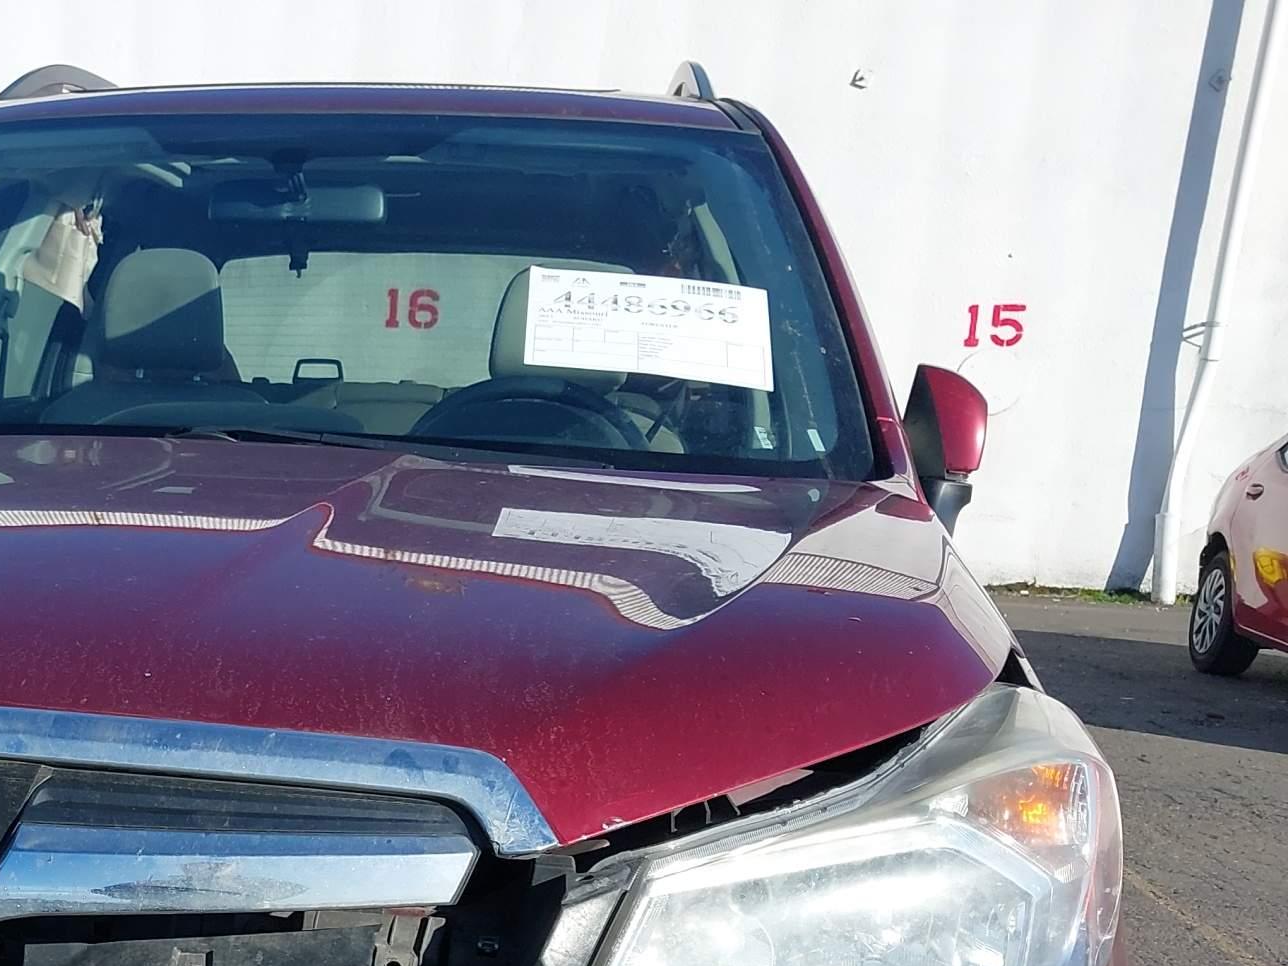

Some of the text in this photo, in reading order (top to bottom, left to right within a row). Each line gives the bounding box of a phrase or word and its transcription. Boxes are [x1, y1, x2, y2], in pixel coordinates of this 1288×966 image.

[385, 288, 440, 329] 16
[553, 290, 739, 325] 44486966
[963, 304, 1027, 347] 15
